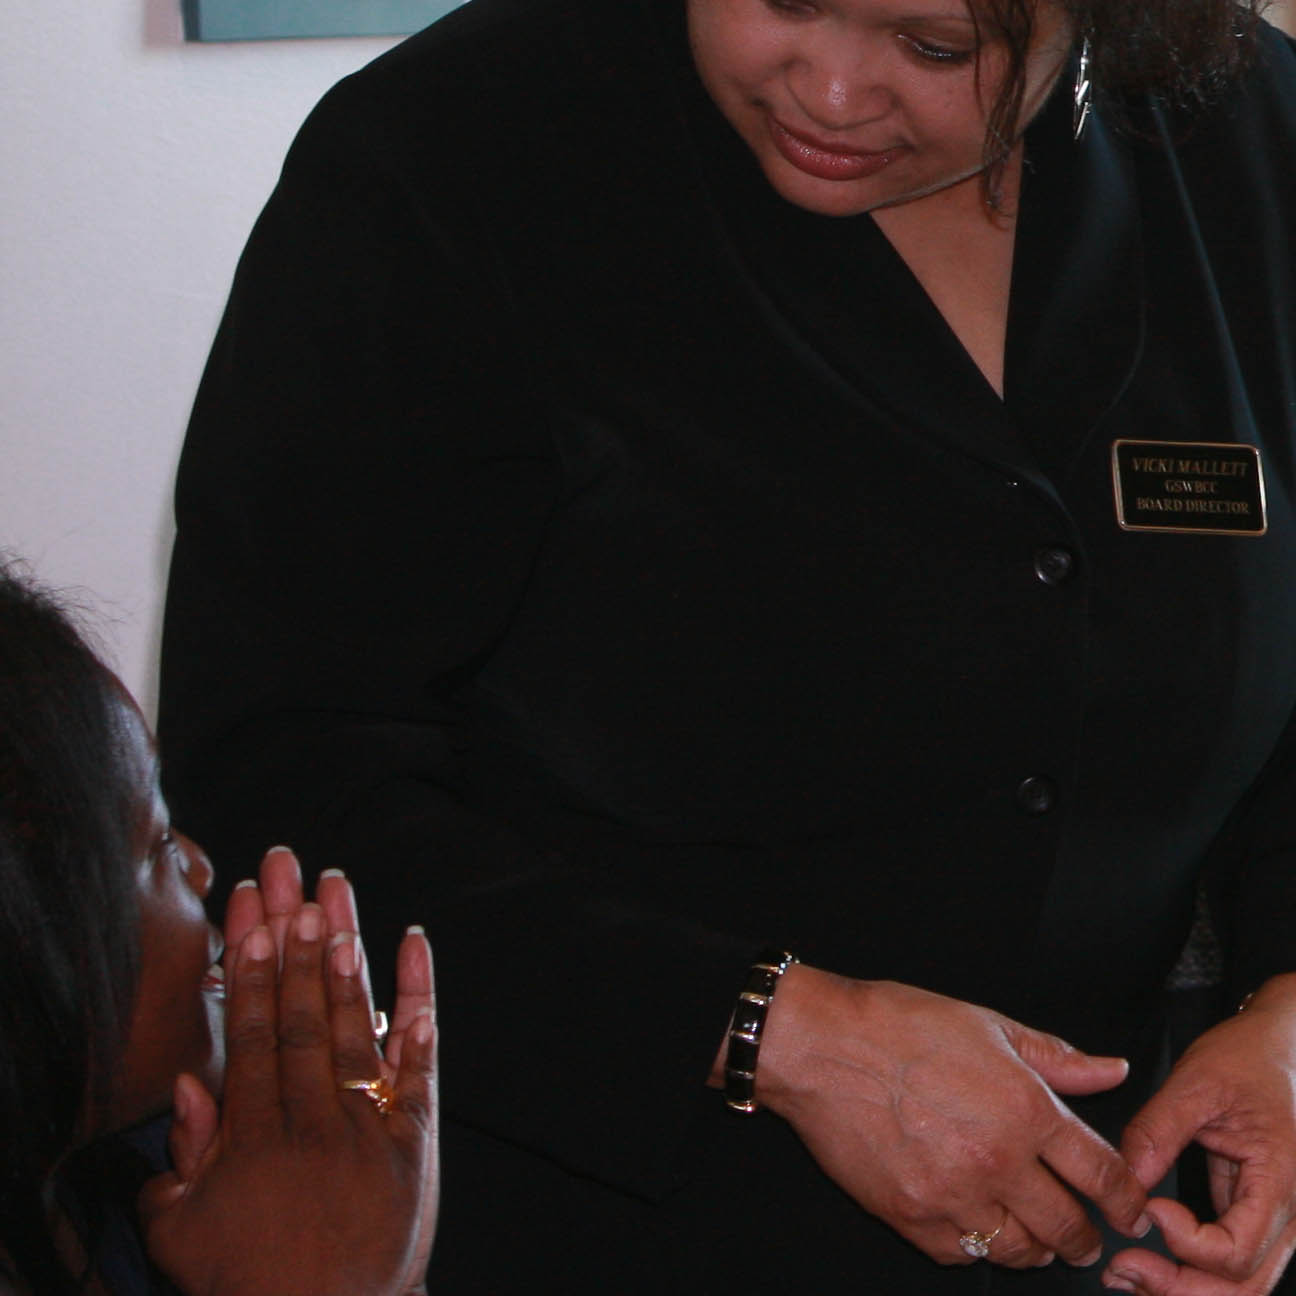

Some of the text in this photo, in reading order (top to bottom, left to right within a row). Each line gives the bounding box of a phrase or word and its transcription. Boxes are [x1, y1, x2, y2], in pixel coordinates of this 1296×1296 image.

[1132, 457, 1174, 473] VICKI
[1136, 497, 1250, 513] BOARD DIRECTOR
